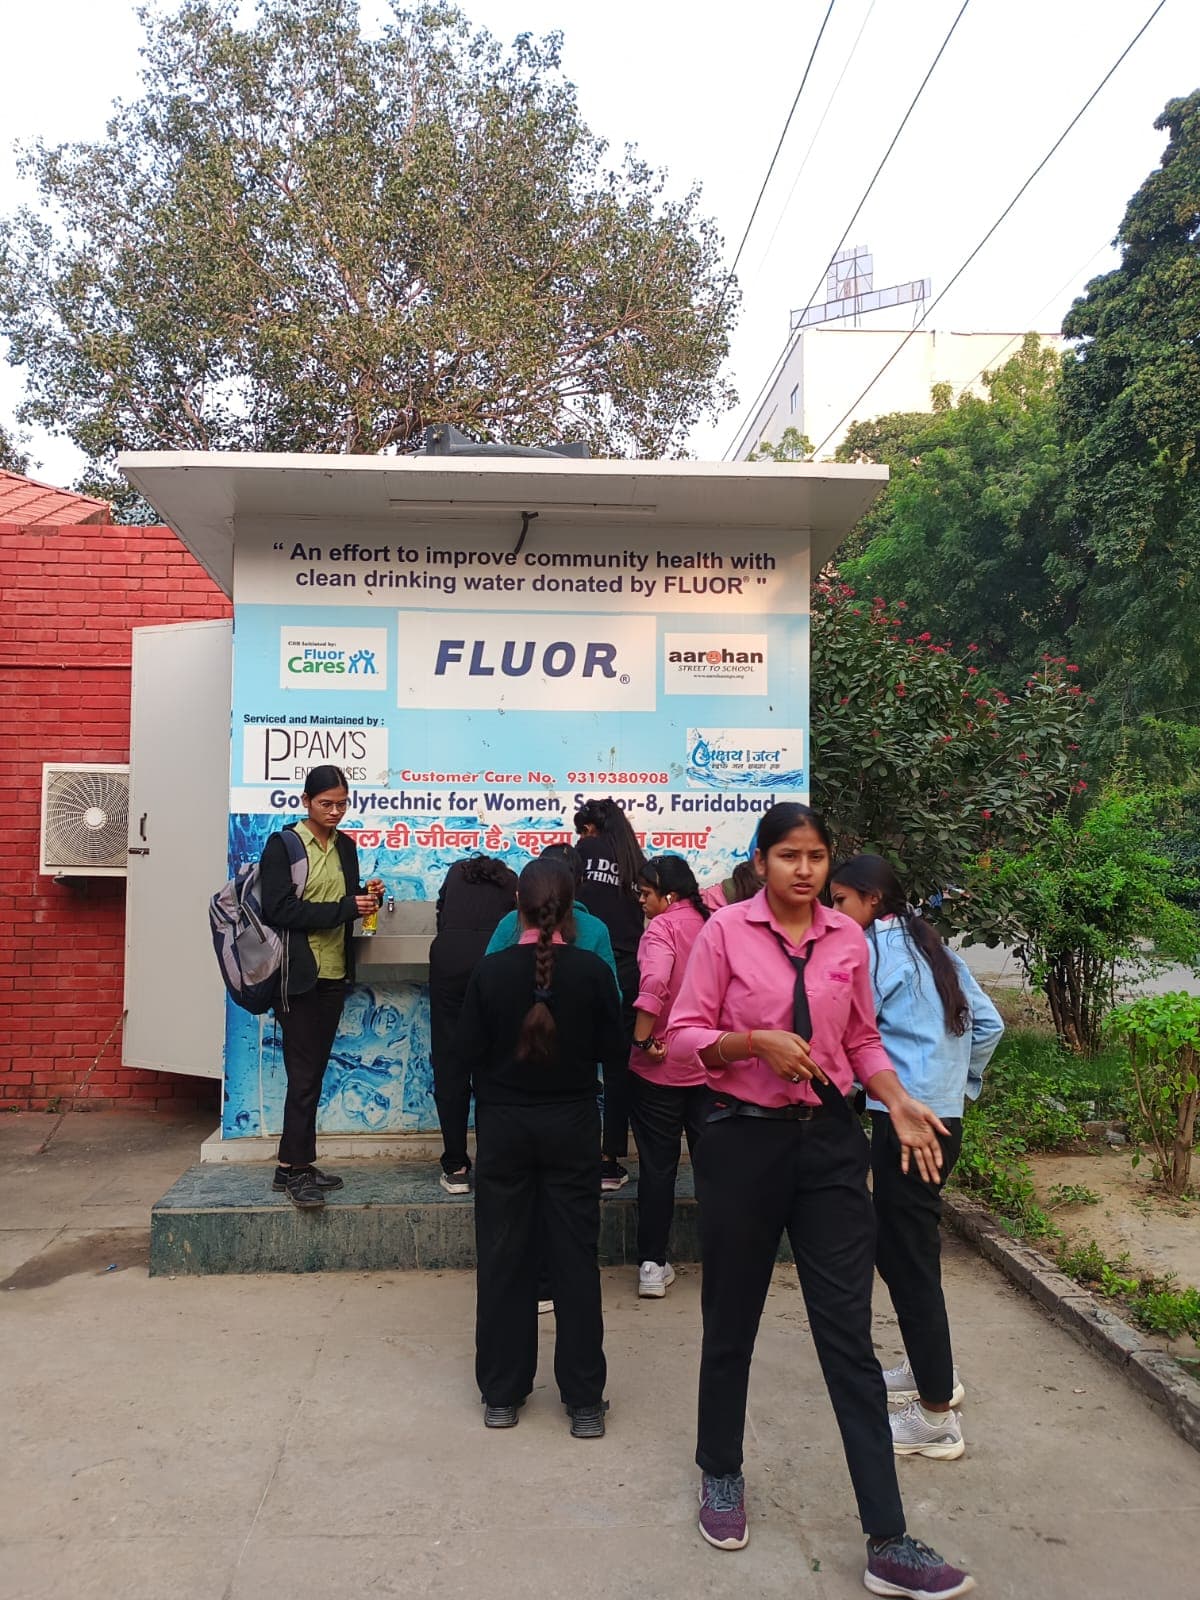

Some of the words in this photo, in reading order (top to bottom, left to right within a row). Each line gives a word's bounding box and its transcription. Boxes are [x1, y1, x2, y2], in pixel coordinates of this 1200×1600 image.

[290, 543, 322, 561] An
[329, 544, 390, 562] effort
[397, 546, 419, 563] to
[426, 547, 517, 568] improve
[524, 550, 649, 571] community
[656, 551, 723, 569] health
[730, 552, 776, 570] with
[296, 568, 356, 587] clean
[364, 570, 456, 593] drinking
[464, 574, 525, 591] water
[531, 575, 623, 593] donated
[630, 576, 656, 597] by
[304, 648, 345, 660] Fluor
[669, 648, 763, 665] aarohan
[288, 656, 345, 673] Cares
[678, 664, 707, 672] STREET
[243, 714, 286, 724] Serviced
[289, 715, 307, 724] and
[310, 716, 365, 725] Maintained
[294, 730, 366, 760] PAM'S
[401, 770, 479, 782] Customer
[484, 771, 522, 783] Care
[528, 772, 556, 783] No.
[567, 772, 669, 784] 9319380908
[348, 790, 441, 814] lytechnic
[448, 791, 478, 811] for
[484, 793, 567, 814] Women,
[386, 823, 410, 848] ही
[416, 823, 479, 848] जीवन
[485, 824, 509, 849] है,
[585, 858, 593, 870] I
